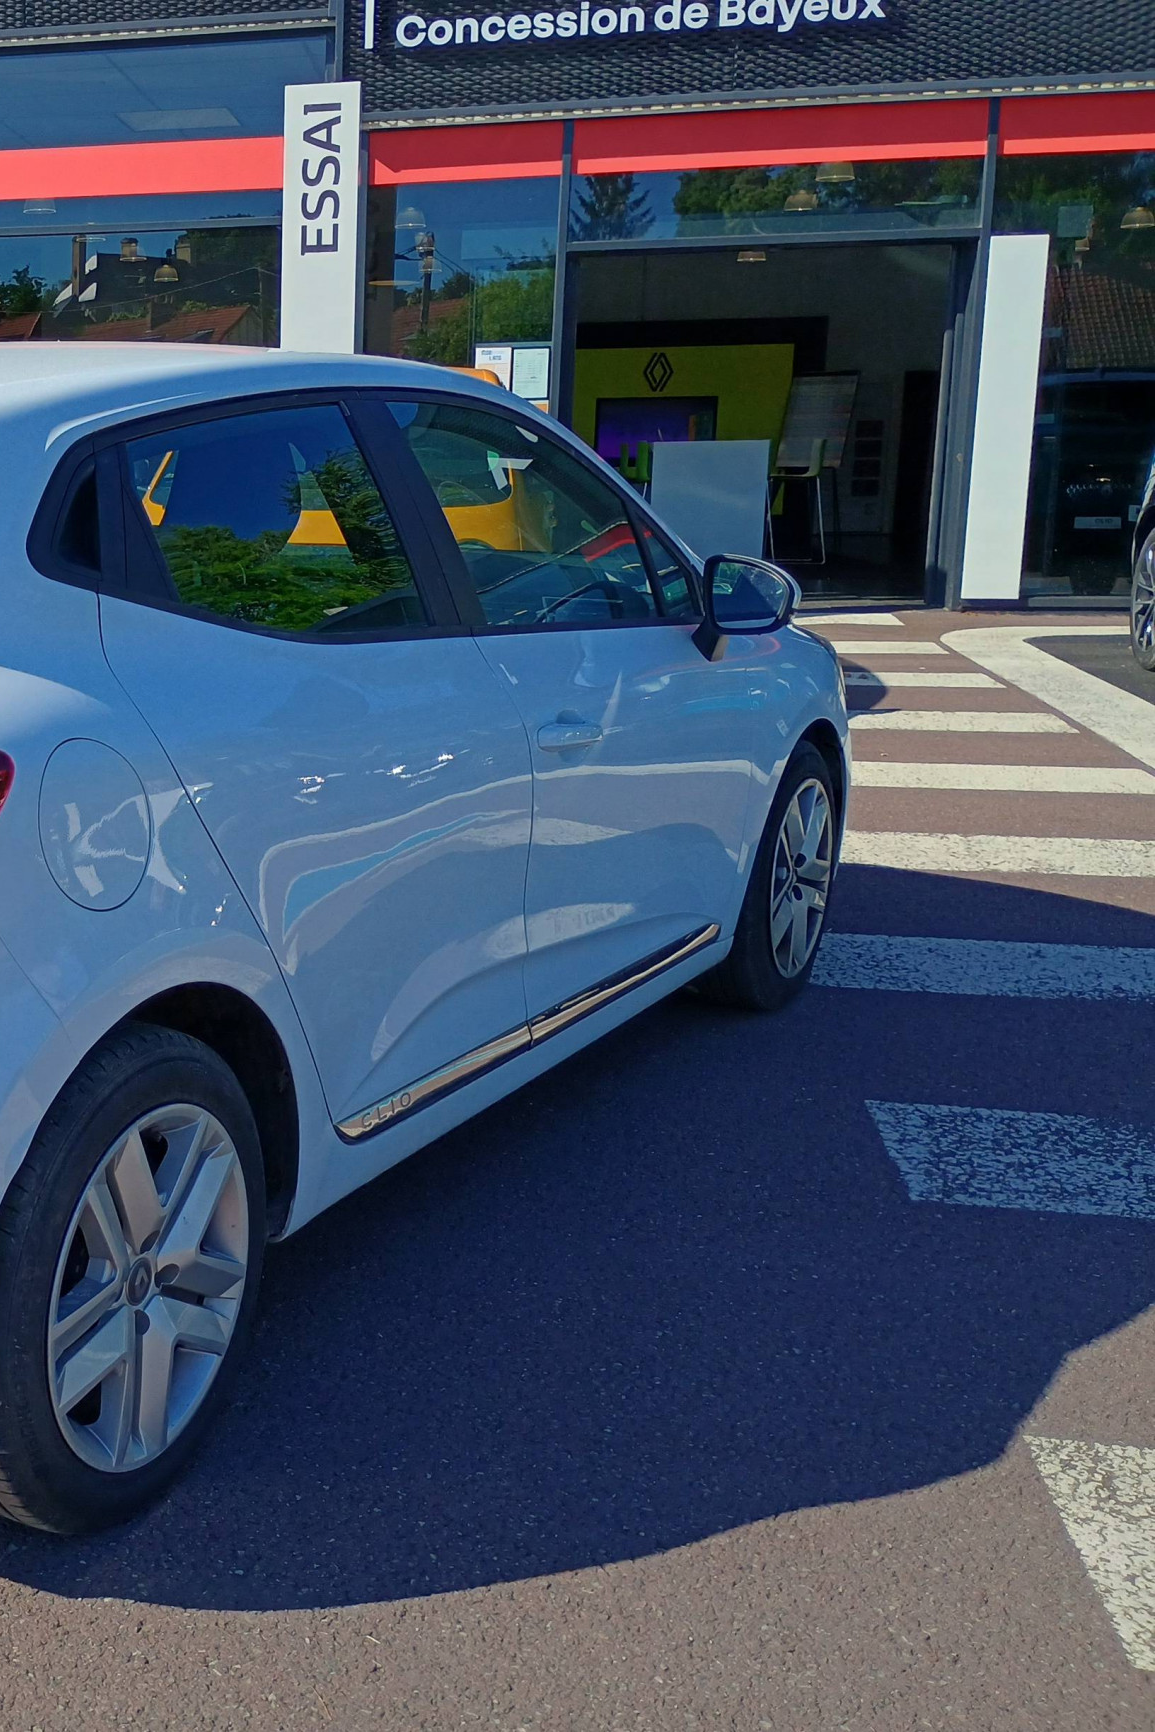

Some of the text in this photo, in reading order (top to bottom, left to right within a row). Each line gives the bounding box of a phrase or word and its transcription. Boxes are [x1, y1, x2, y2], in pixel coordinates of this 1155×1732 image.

[396, 0, 886, 47] Concession de Bayeux
[301, 103, 342, 256] ESSAI
[361, 1091, 412, 1128] CLIO
